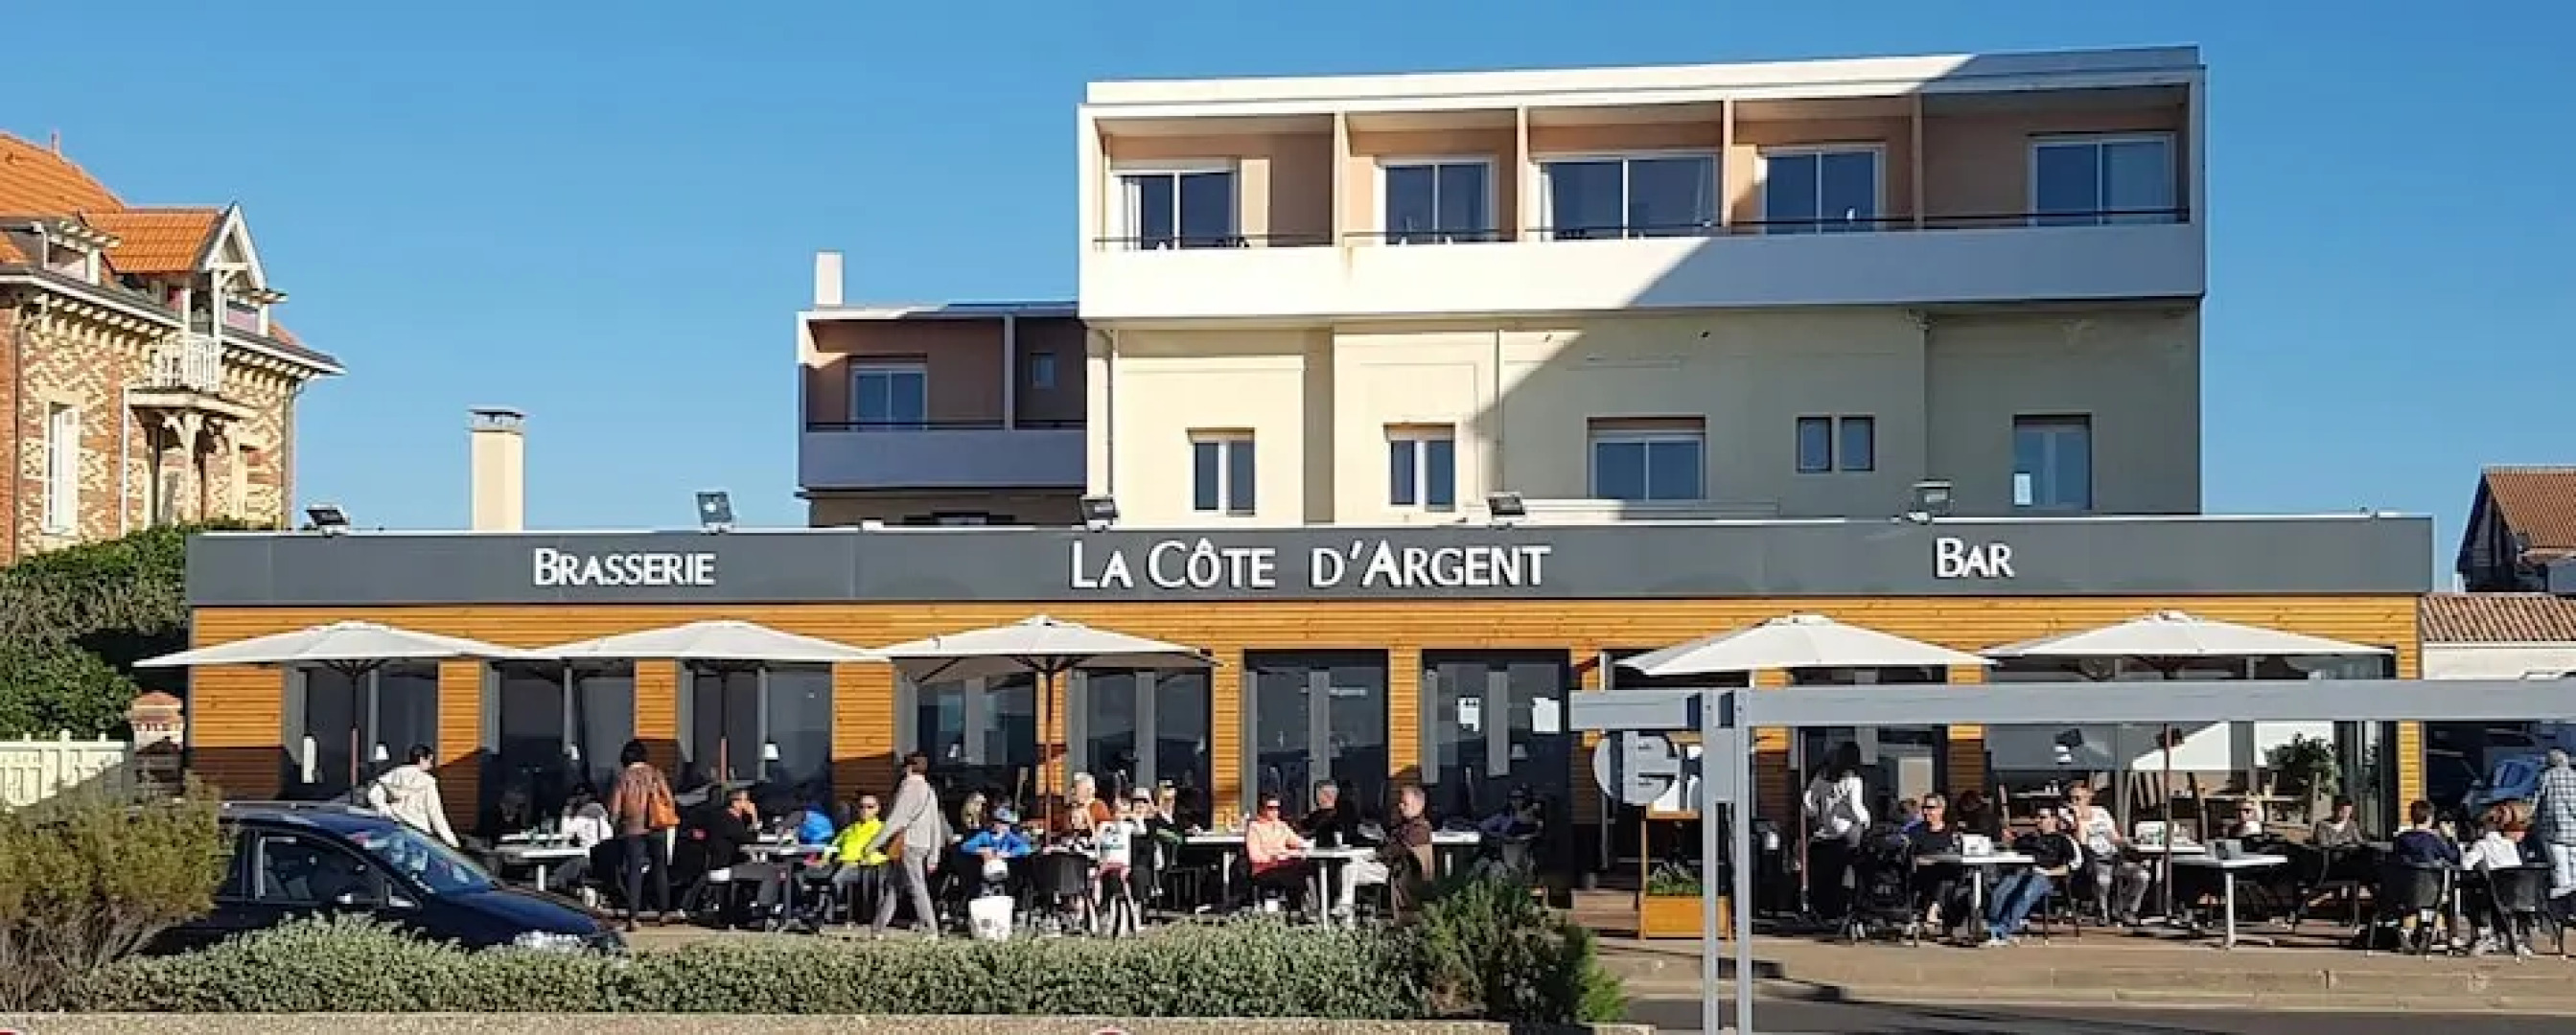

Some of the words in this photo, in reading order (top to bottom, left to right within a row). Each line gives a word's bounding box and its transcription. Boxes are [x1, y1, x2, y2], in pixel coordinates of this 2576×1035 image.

[534, 547, 715, 586] BRASSERIE
[1072, 540, 1133, 587] LA
[1148, 537, 1276, 587] CÔTE
[1936, 537, 2015, 578] BAR
